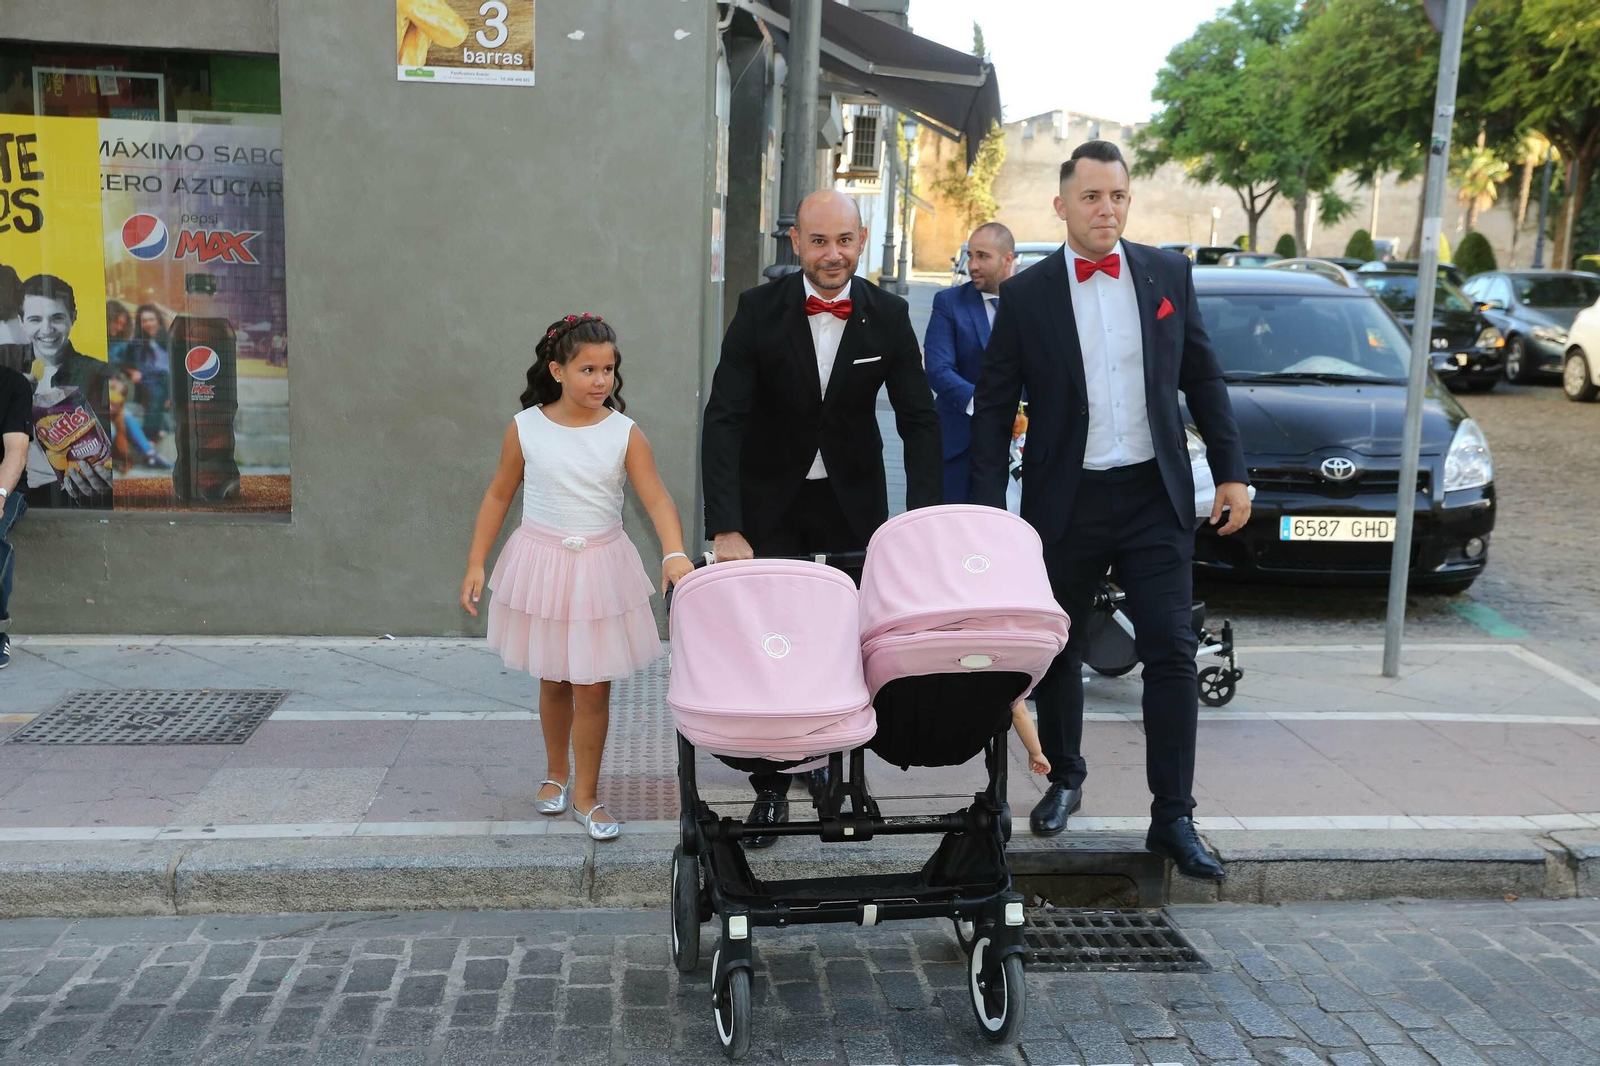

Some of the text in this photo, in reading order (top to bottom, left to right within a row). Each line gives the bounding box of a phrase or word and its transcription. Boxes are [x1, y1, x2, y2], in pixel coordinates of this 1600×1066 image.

[475, 0, 508, 48] 3
[463, 47, 524, 66] barras
[100, 173, 163, 194] ERO
[181, 213, 219, 225] pepsi
[172, 229, 264, 265] MAX
[36, 405, 90, 446] Ruffles
[1294, 520, 1389, 538] 6587 GHD
